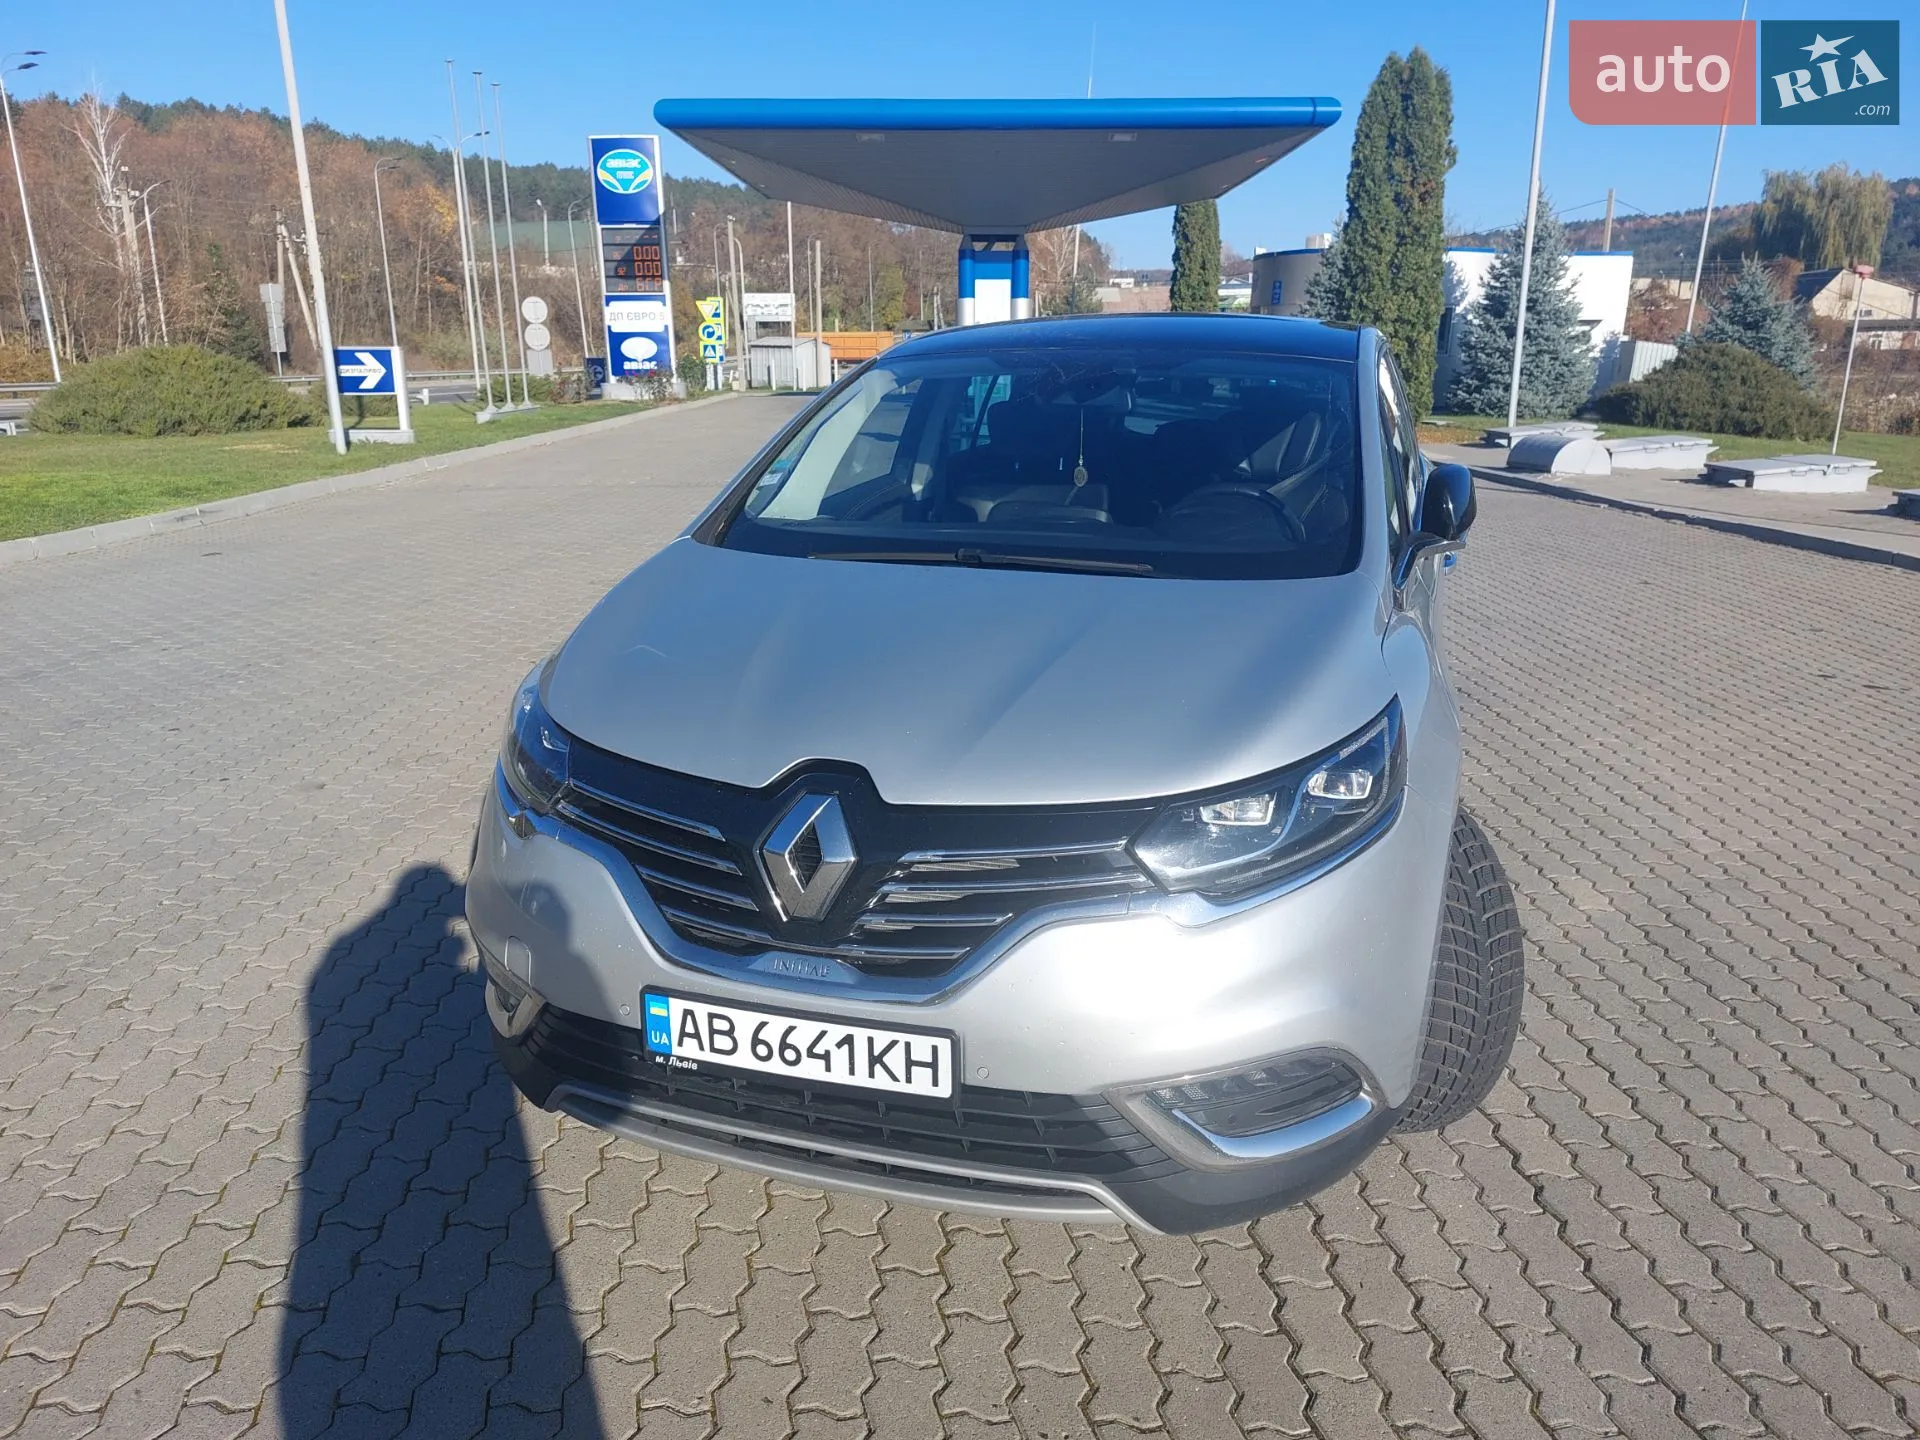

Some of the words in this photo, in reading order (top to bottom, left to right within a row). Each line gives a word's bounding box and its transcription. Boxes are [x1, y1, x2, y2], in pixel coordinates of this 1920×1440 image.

[609, 311, 624, 322] ДП
[626, 311, 656, 321] ЄВРО
[651, 1031, 670, 1046] UA
[677, 1008, 739, 1056] AB
[867, 1036, 939, 1088] KH
[668, 1055, 698, 1070] Львів
